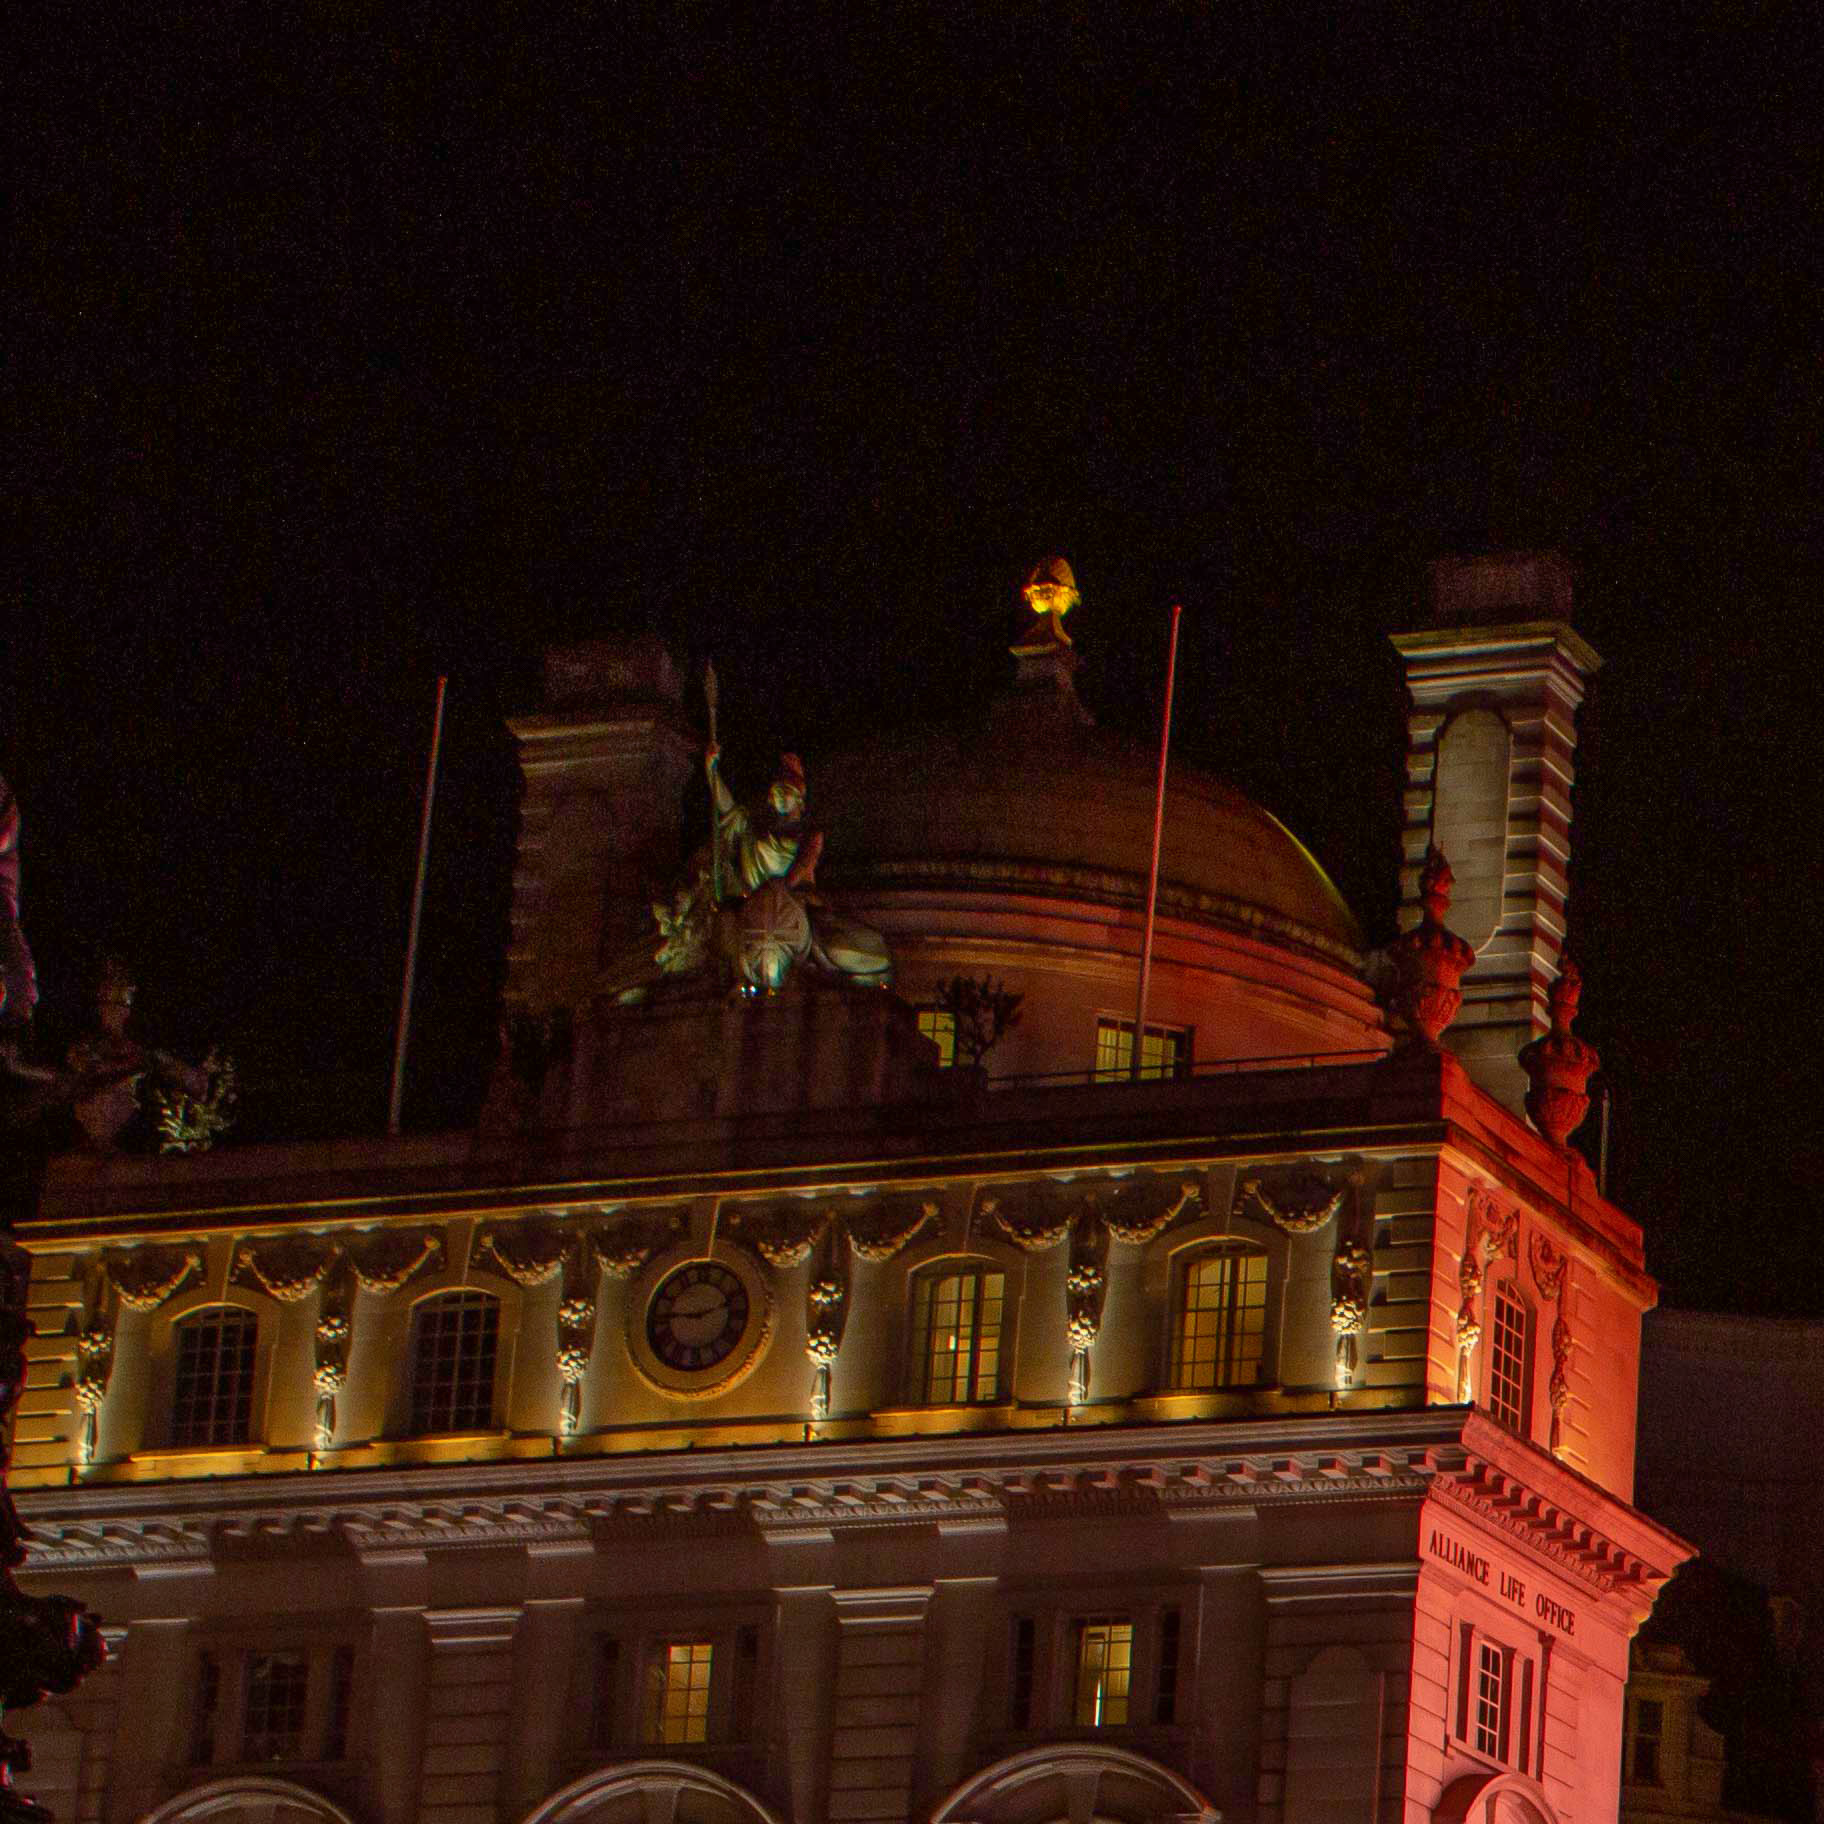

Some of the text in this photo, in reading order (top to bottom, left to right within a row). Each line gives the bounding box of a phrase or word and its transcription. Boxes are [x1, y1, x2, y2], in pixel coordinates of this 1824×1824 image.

[1429, 1529, 1576, 1636] ALLIANCE LIFE OFFICE
